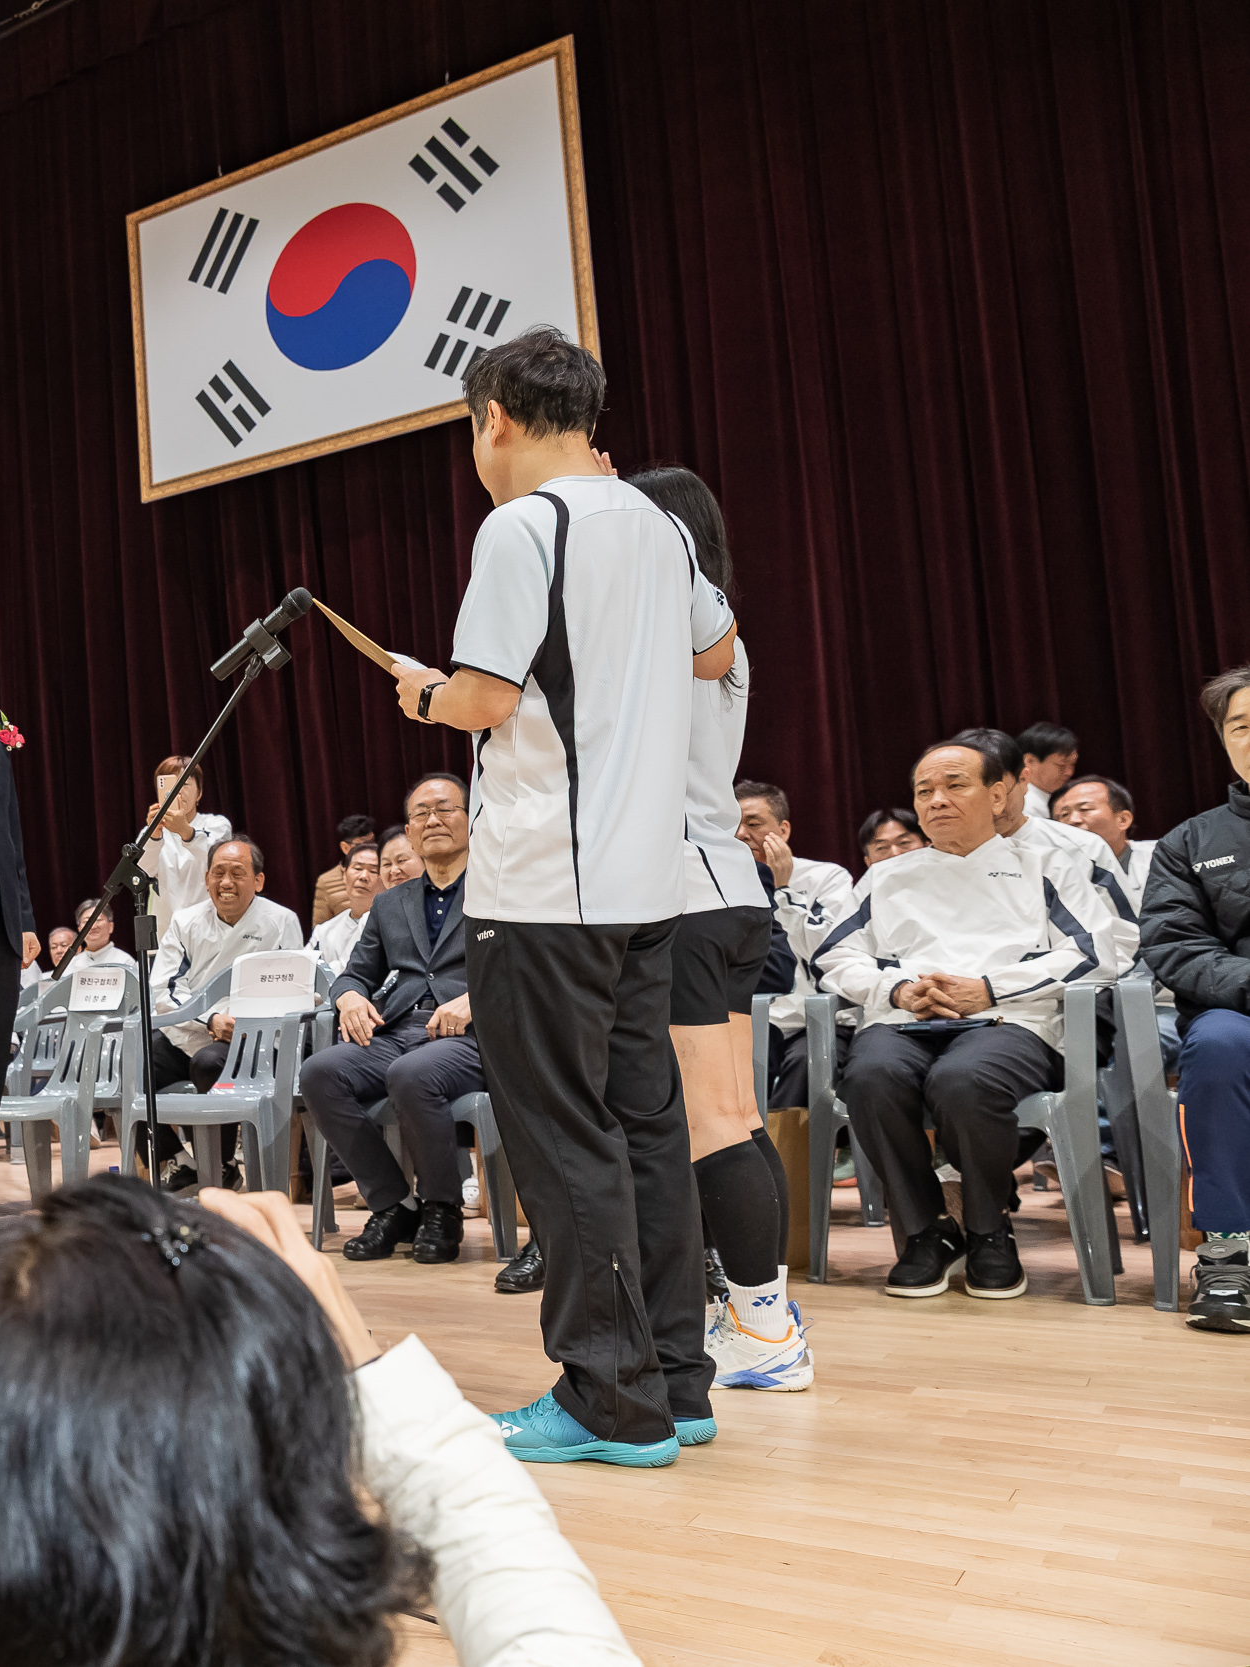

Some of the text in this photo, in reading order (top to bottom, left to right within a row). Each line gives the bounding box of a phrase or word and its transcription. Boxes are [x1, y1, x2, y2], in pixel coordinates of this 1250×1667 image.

[1203, 855, 1235, 869] YONEX
[476, 929, 495, 941] vitro
[80, 977, 118, 986] 광진구협회장
[260, 973, 294, 982] 광진구청장
